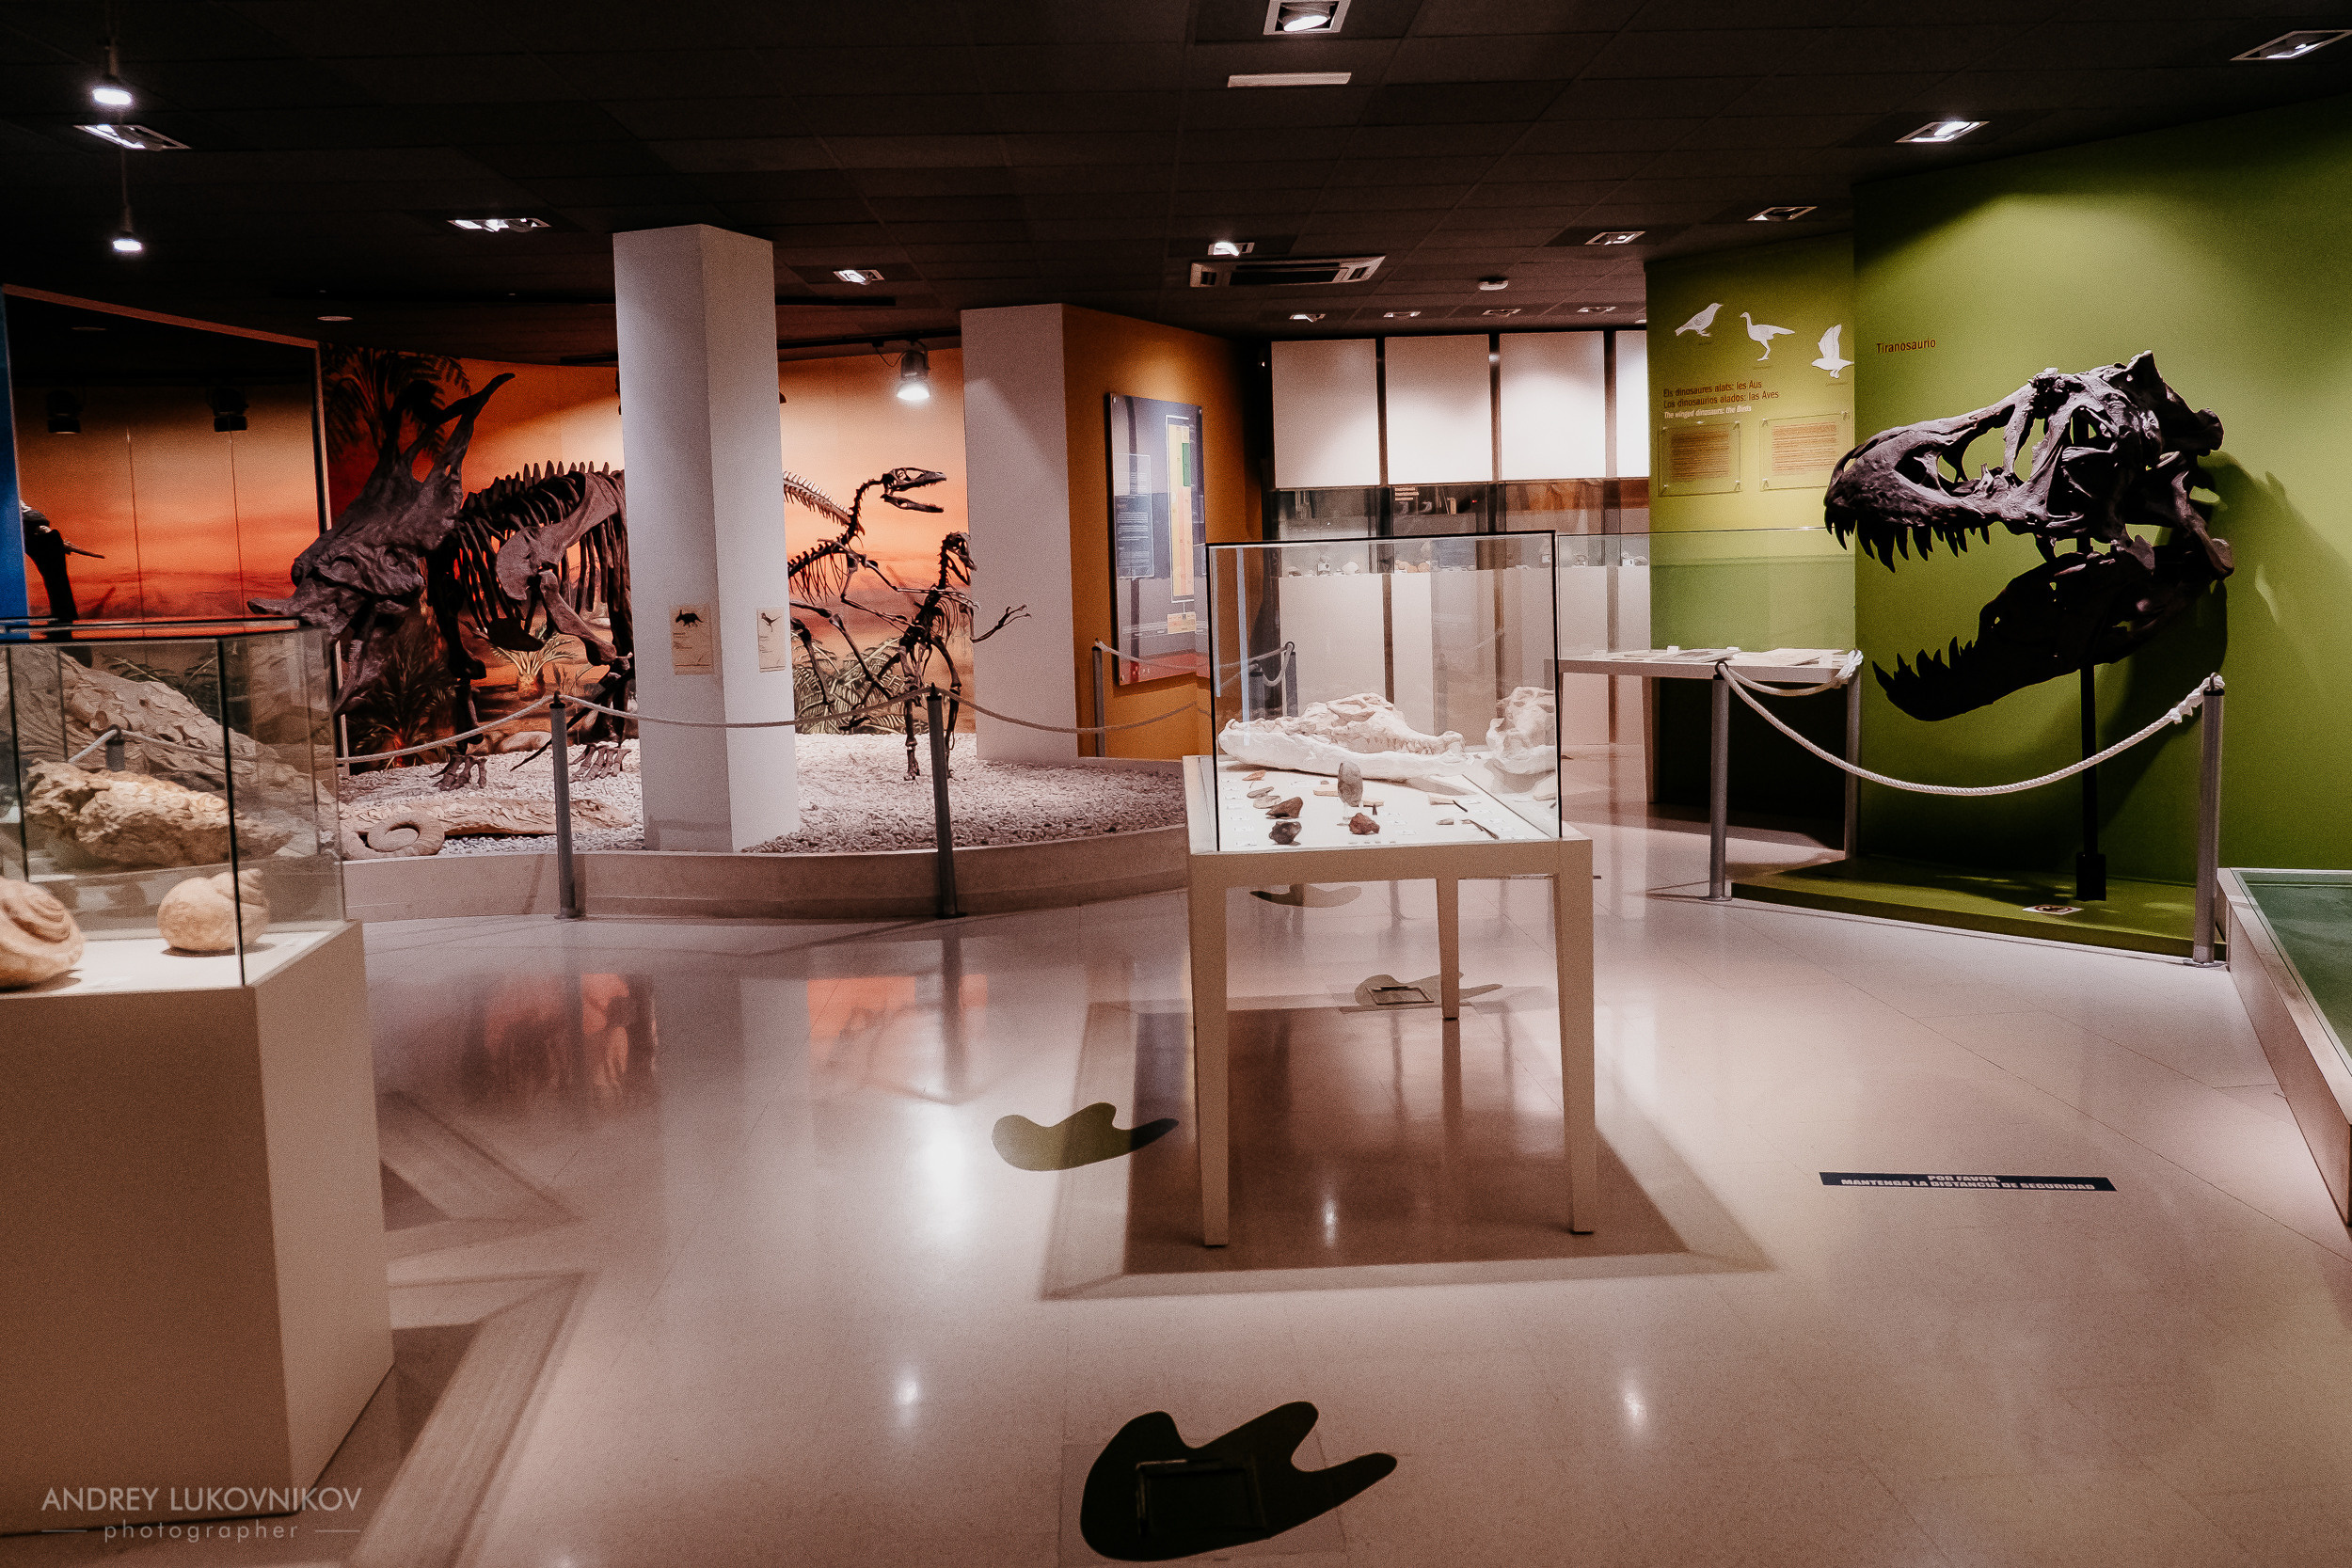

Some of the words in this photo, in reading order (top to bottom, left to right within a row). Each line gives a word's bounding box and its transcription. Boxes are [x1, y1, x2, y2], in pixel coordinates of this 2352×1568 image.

[1876, 338, 1937, 354] Tiranosaurio
[1663, 388, 1674, 398] Els
[1675, 385, 1713, 397] dinosaures
[1714, 383, 1734, 392] alats:
[1736, 381, 1747, 390] les
[1749, 380, 1762, 388] Aus
[1663, 399, 1676, 409] Los
[1677, 395, 1718, 407] dinosaurios
[1720, 393, 1747, 404] alados:
[1748, 391, 1760, 401] las
[1761, 390, 1779, 400] Aves
[1675, 409, 1695, 420] winged
[1695, 407, 1724, 417] dinosaurs:
[2019, 1182, 2096, 1191] SEGURIDAD
